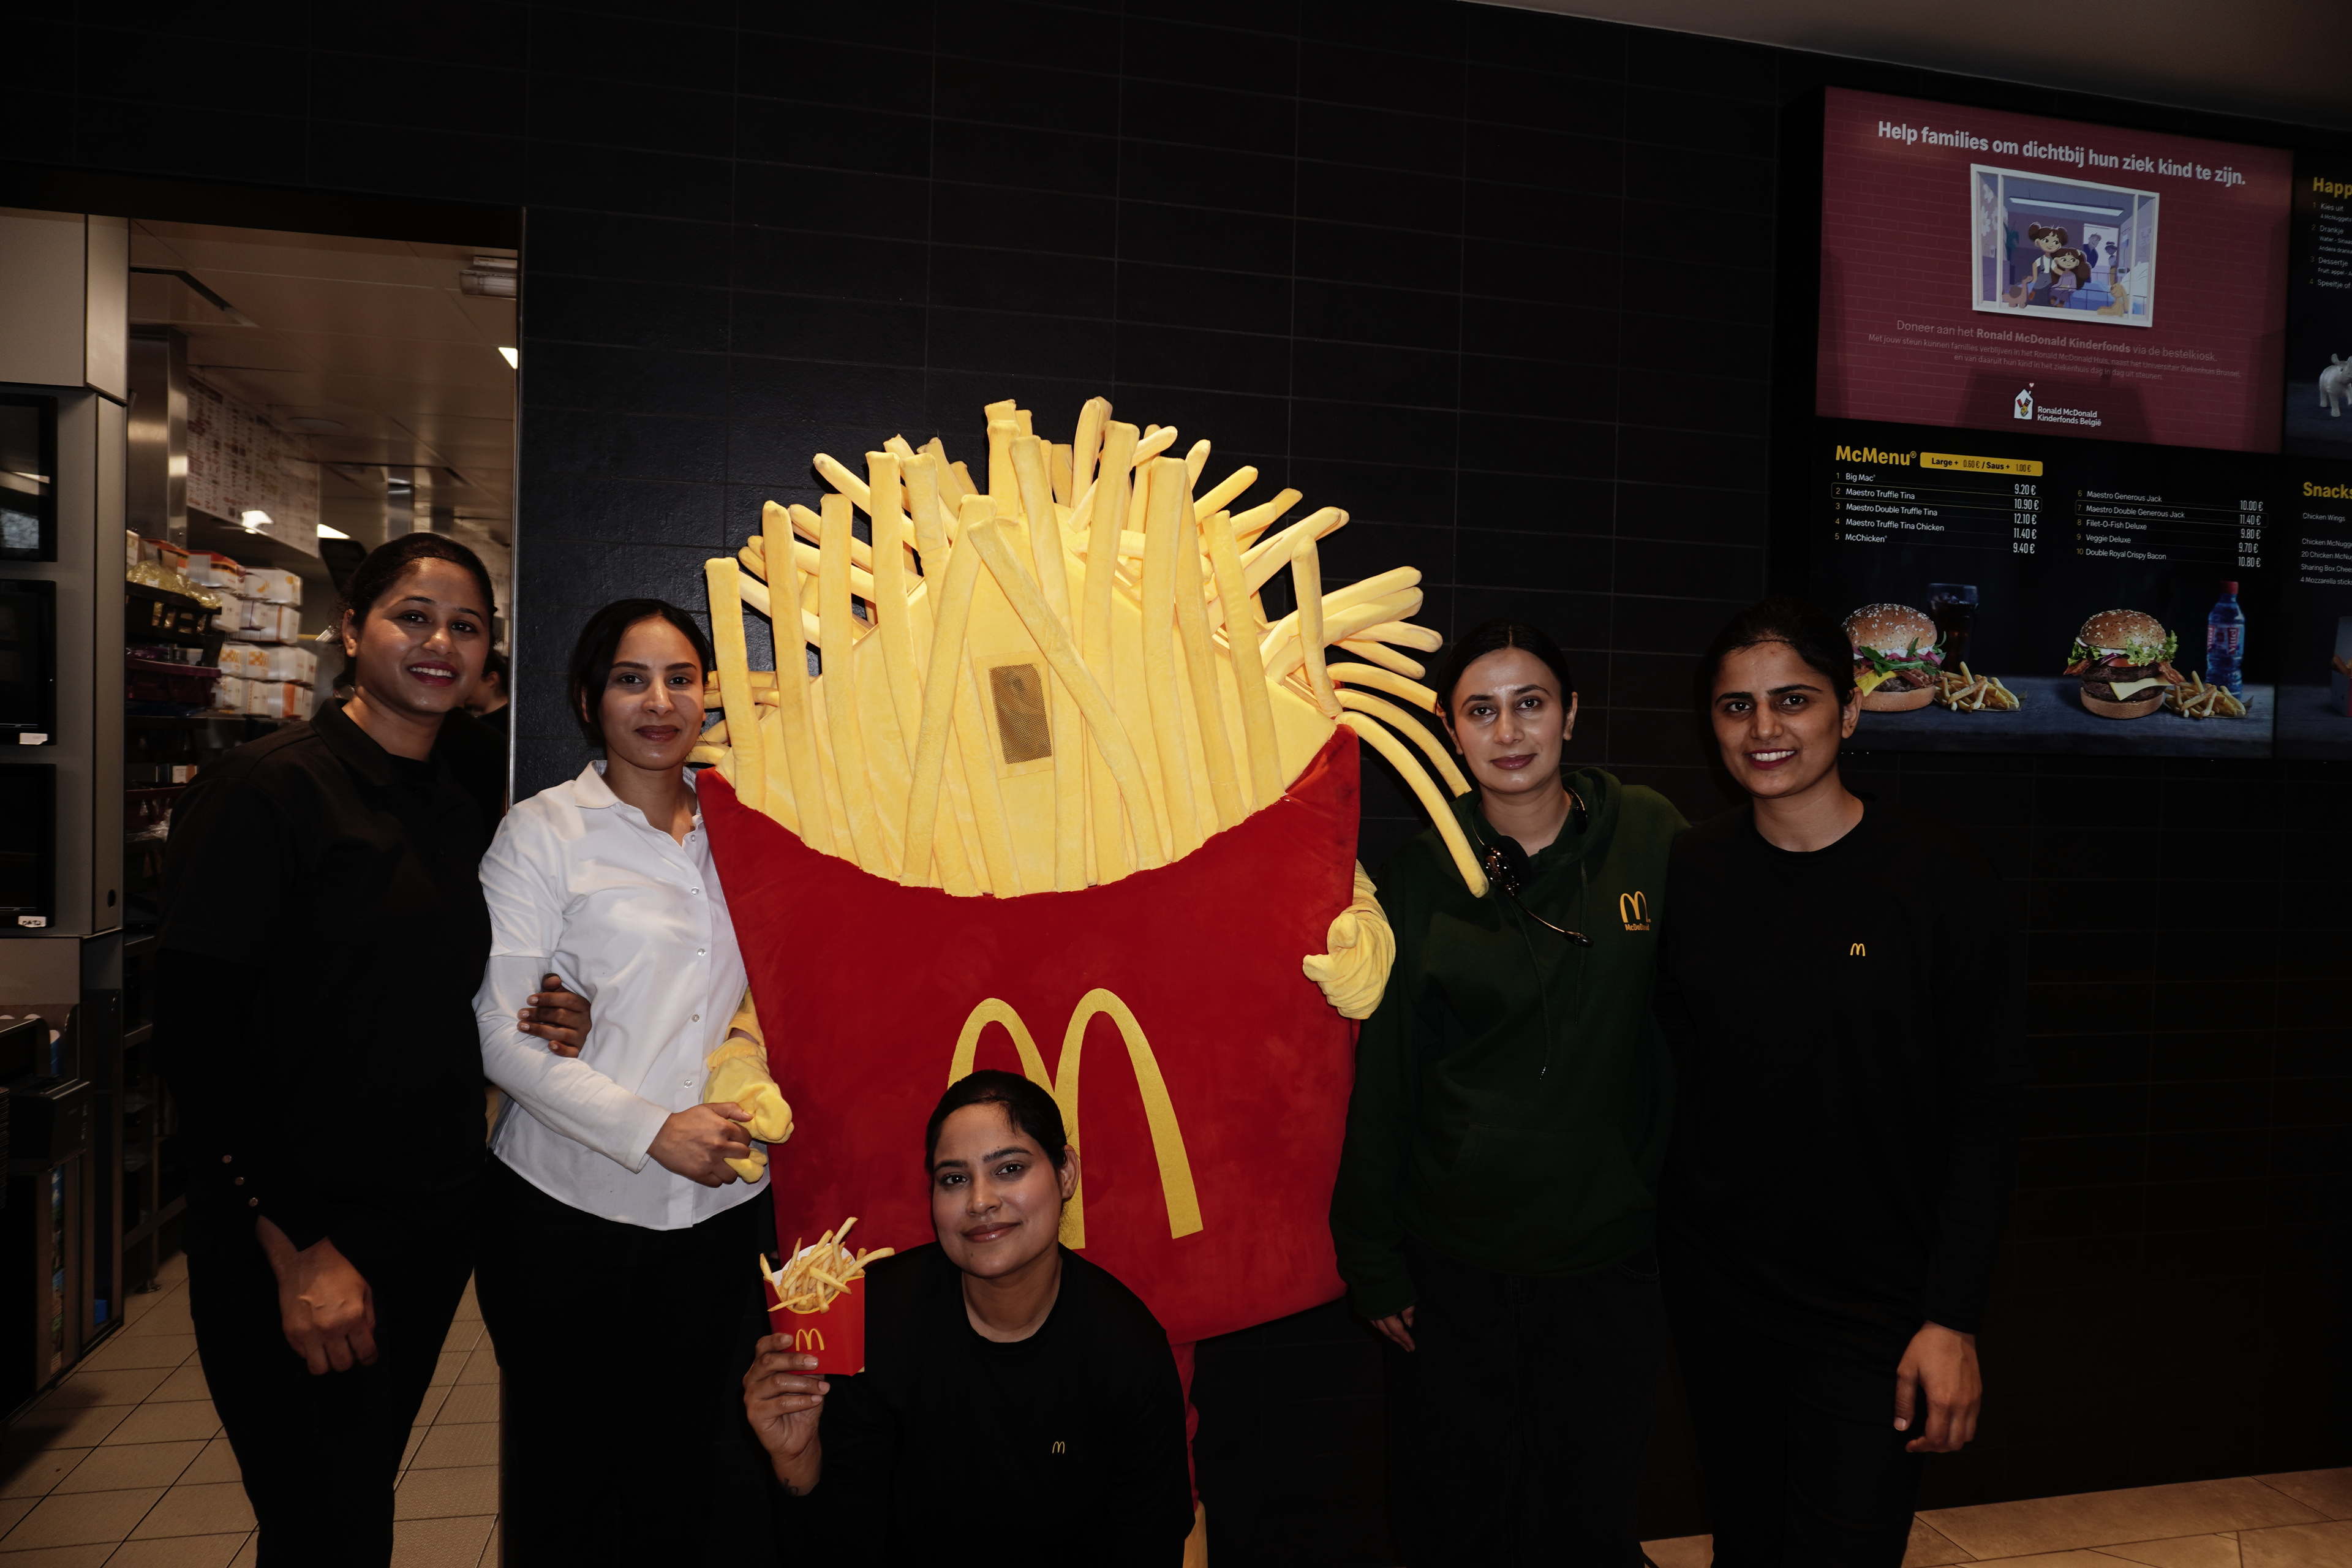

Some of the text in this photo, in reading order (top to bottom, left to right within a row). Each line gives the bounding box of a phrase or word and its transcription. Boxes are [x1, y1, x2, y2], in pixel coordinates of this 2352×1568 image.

[1879, 121, 2245, 187] Help families om dichtbij hun ziek kind te zijn.
[2320, 225, 2344, 235] Drankje
[2318, 257, 2348, 267] Dessertje
[2317, 279, 2343, 289] Speeltje
[1897, 320, 2217, 361] Doneer aan het Ronald McDonald Kinderfonds via de bestelkiosk.
[1883, 335, 1901, 344] jouw
[1923, 339, 1950, 349] kunnen
[1951, 342, 1978, 352] families
[1980, 345, 2013, 355] verblijven
[2034, 351, 2057, 360] Ronald
[2059, 353, 2092, 363] McDonald
[1978, 356, 2002, 365] daaruit
[2003, 357, 2016, 366] hun
[2054, 363, 2089, 373] ziekenhuis
[2090, 367, 2103, 376] dag
[2038, 406, 2097, 418] Ronald McDonald
[2037, 414, 2101, 427] Kinderfonds België
[1931, 458, 1953, 467] Large
[1963, 459, 1975, 468] 0.60
[1845, 472, 1857, 482] Big
[1845, 488, 1875, 497] Maestro
[1876, 490, 1899, 499] Truffle
[2015, 484, 2029, 495] 9.20
[2087, 491, 2113, 499] Maestro
[2114, 492, 2146, 501] Generous
[1846, 503, 1874, 512] Maestro
[1875, 505, 1899, 513] Double
[1900, 507, 1922, 515] Truffle
[1923, 508, 1938, 516] Tina
[2015, 499, 2032, 510] 10.90
[2240, 500, 2257, 511] 10.00
[2014, 513, 2030, 524] 12.10
[2086, 519, 2124, 529] Filet-O-Fish
[2239, 514, 2255, 525] 11.40
[1876, 520, 1899, 529] Truffle
[1916, 523, 1945, 532] Chicken
[2014, 527, 2030, 539] 11.40
[2086, 534, 2108, 543] Veggie
[2241, 528, 2255, 539] 9.80
[2013, 542, 2029, 553] 9.40
[2239, 542, 2252, 552] 9.70
[2086, 548, 2108, 557] Double
[2109, 550, 2126, 559] Royal
[2127, 551, 2146, 560] Crispy
[2238, 556, 2255, 567] 10.80
[2301, 564, 2323, 572] Sharing
